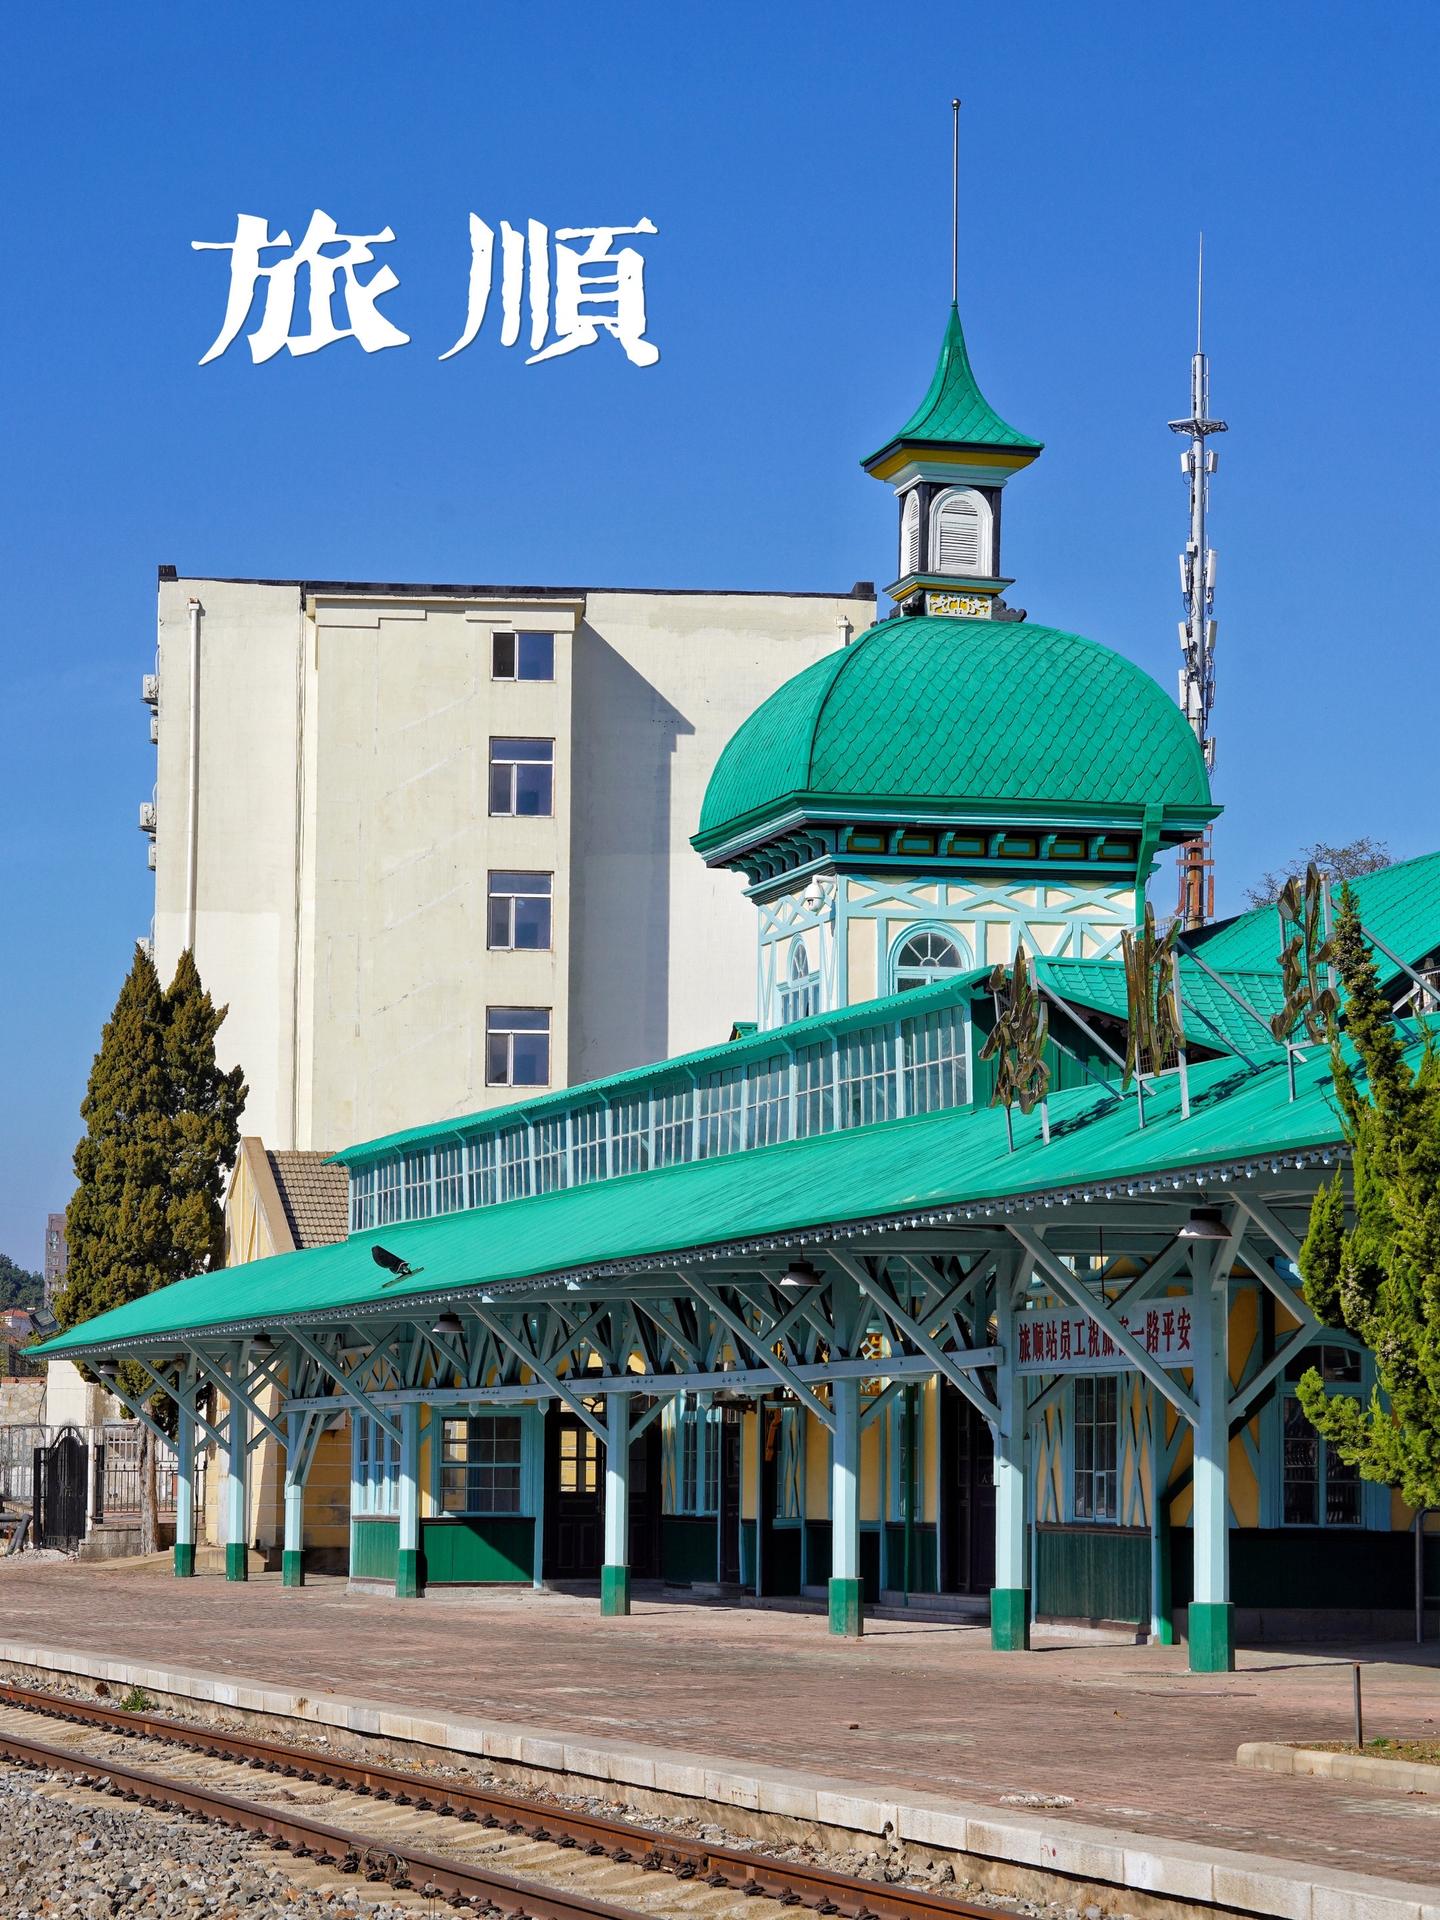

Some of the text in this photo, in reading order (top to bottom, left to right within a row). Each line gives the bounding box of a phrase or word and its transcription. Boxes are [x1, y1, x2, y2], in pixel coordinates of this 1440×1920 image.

[1018, 1307, 1192, 1363] 旅顺站员工祝旅一路平安
